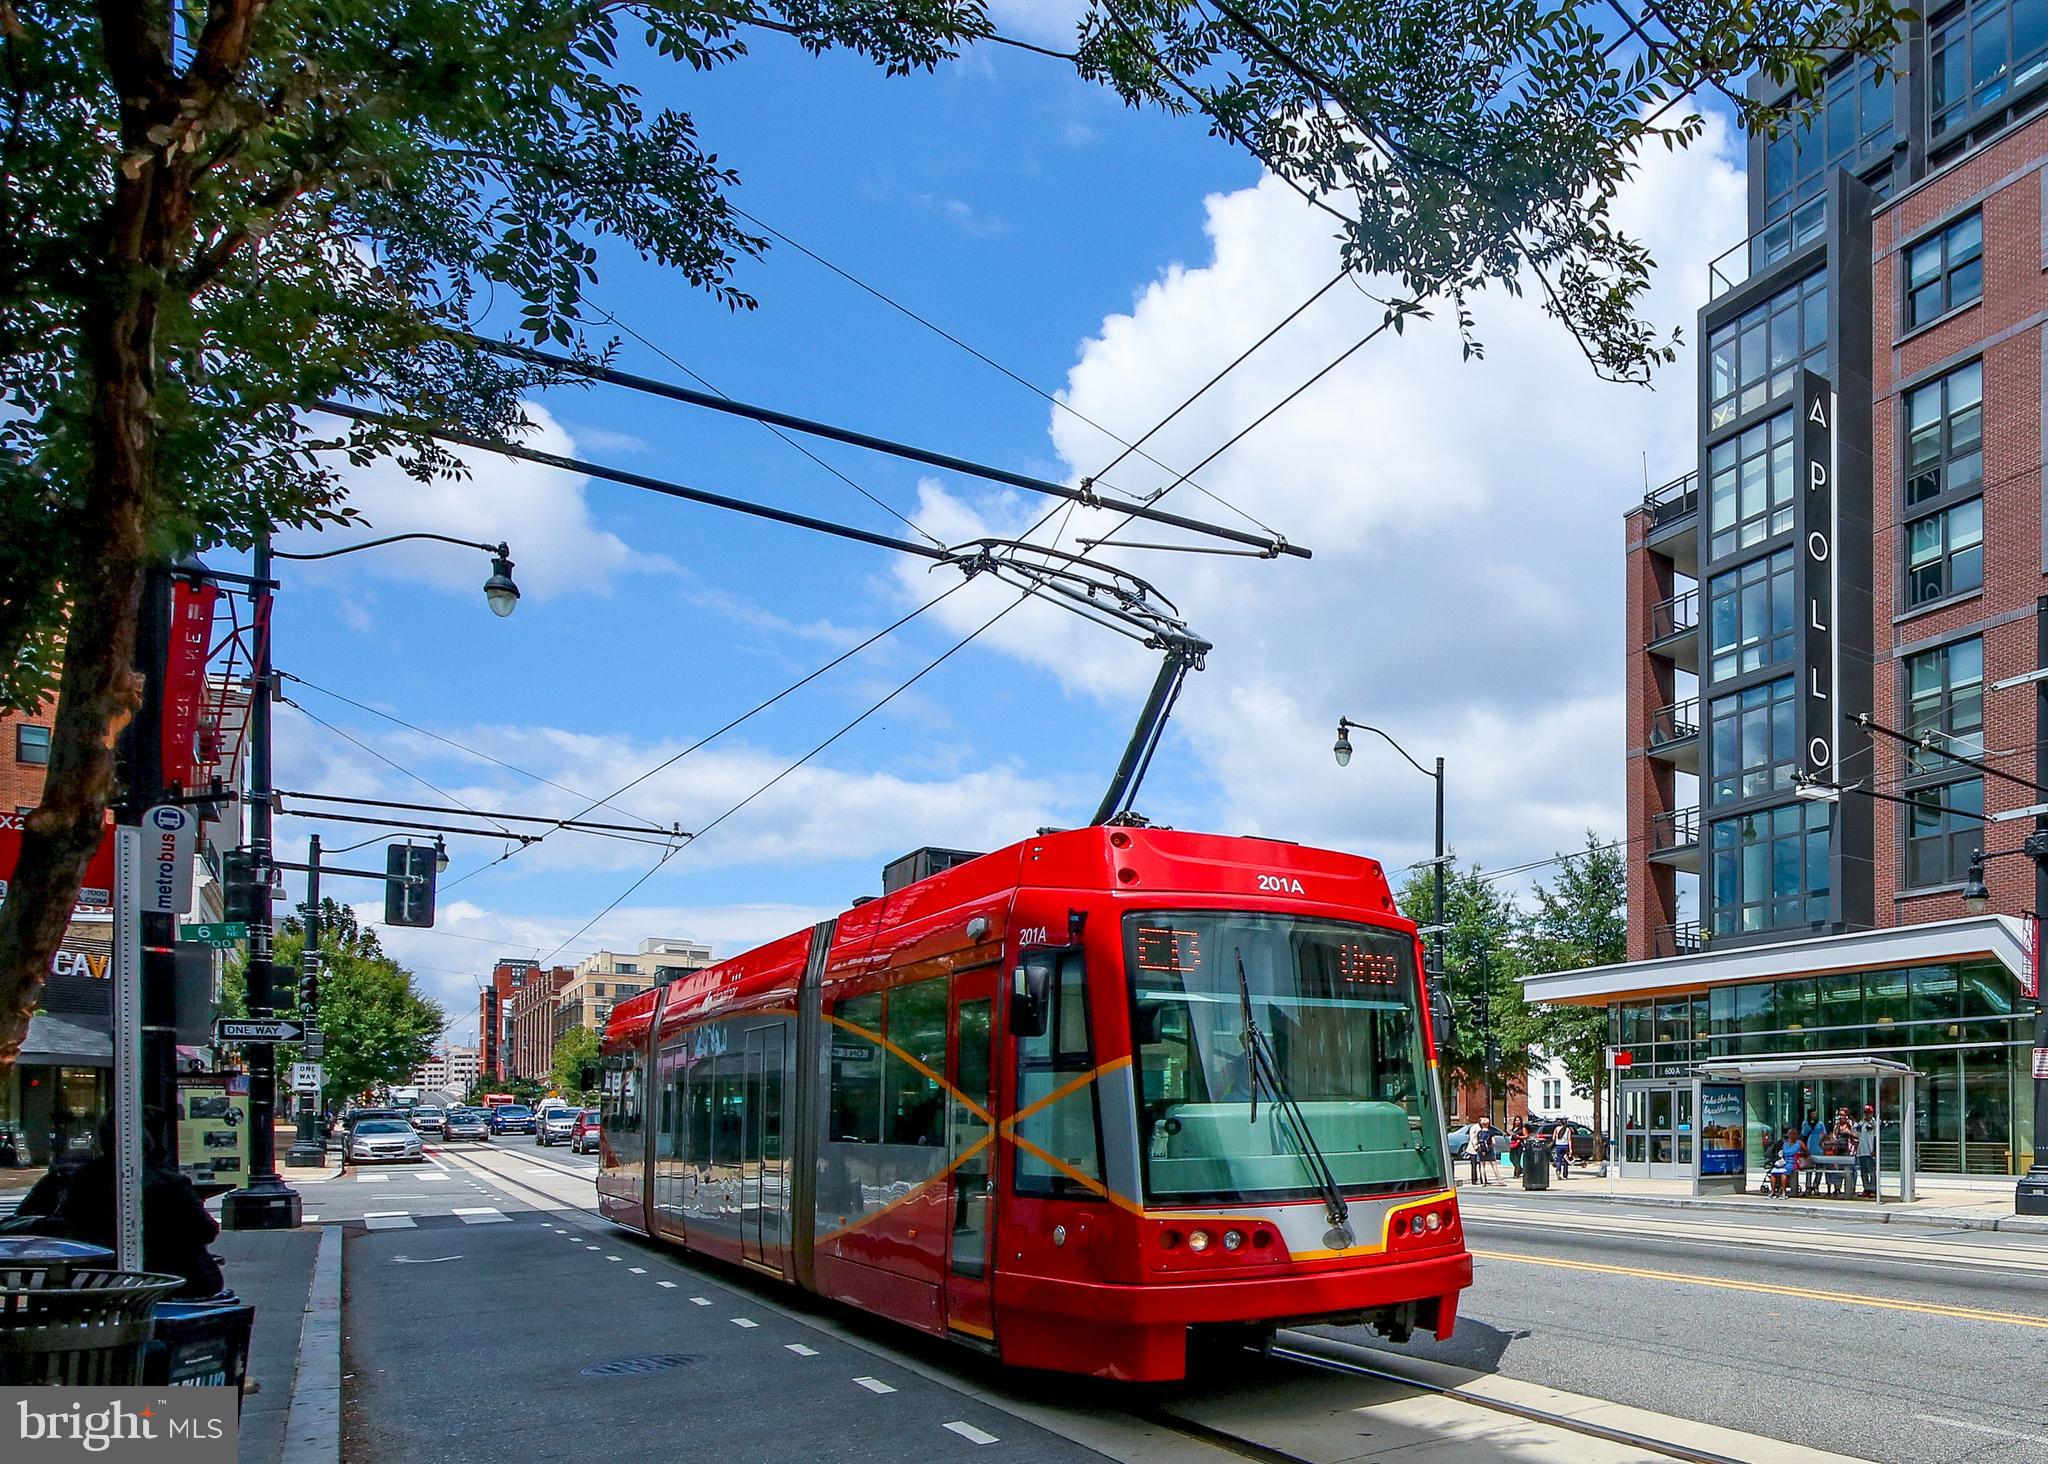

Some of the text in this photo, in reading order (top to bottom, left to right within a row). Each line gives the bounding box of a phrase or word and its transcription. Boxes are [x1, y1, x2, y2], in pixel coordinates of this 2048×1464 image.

[1808, 392, 1830, 767] APOLLO
[156, 832, 176, 909] metrobus
[1257, 874, 1305, 895] 201A
[197, 926, 211, 938] 6
[1020, 926, 1047, 945] 201A
[227, 1025, 280, 1035] ONE WAY
